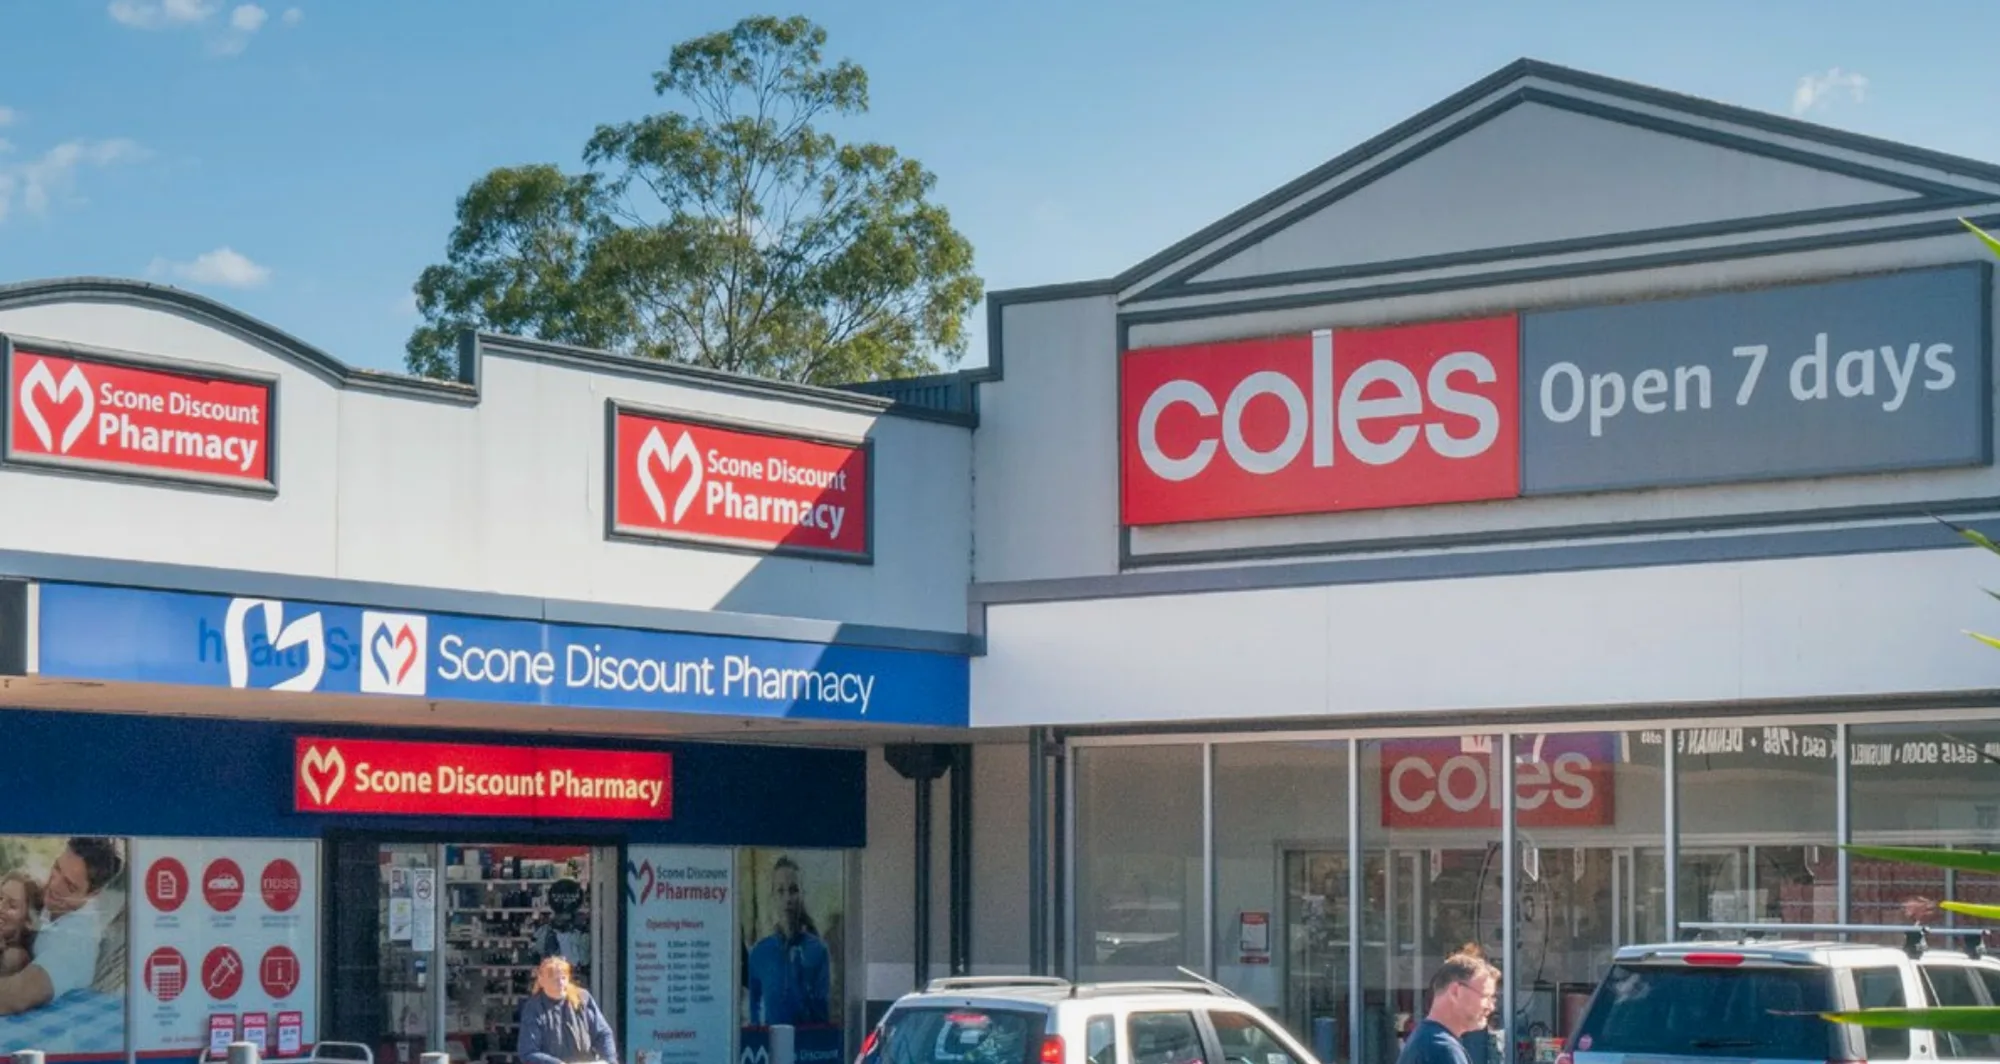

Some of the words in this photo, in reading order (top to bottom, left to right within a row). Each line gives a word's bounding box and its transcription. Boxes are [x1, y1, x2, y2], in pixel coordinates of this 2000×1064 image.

[100, 382, 164, 413] Scone
[169, 392, 260, 426] Discount
[1137, 329, 1500, 482] coles
[1539, 361, 1712, 437] Open
[1732, 344, 1769, 406] 7
[1789, 332, 1956, 412] days
[97, 412, 259, 472] Pharmacy
[707, 449, 763, 480] Scone
[767, 457, 847, 492] Discount
[706, 480, 845, 540] Pharmacy
[438, 634, 554, 686] Scone
[566, 644, 715, 696] Discount
[722, 655, 875, 714] Pharmacy
[355, 763, 432, 793] Scone
[437, 765, 546, 797] Discount
[550, 769, 663, 807] Pharmacy
[1388, 738, 1594, 813] coles
[656, 866, 685, 880] Scone
[687, 866, 727, 880] Discount
[656, 882, 727, 905] Pharmacy
